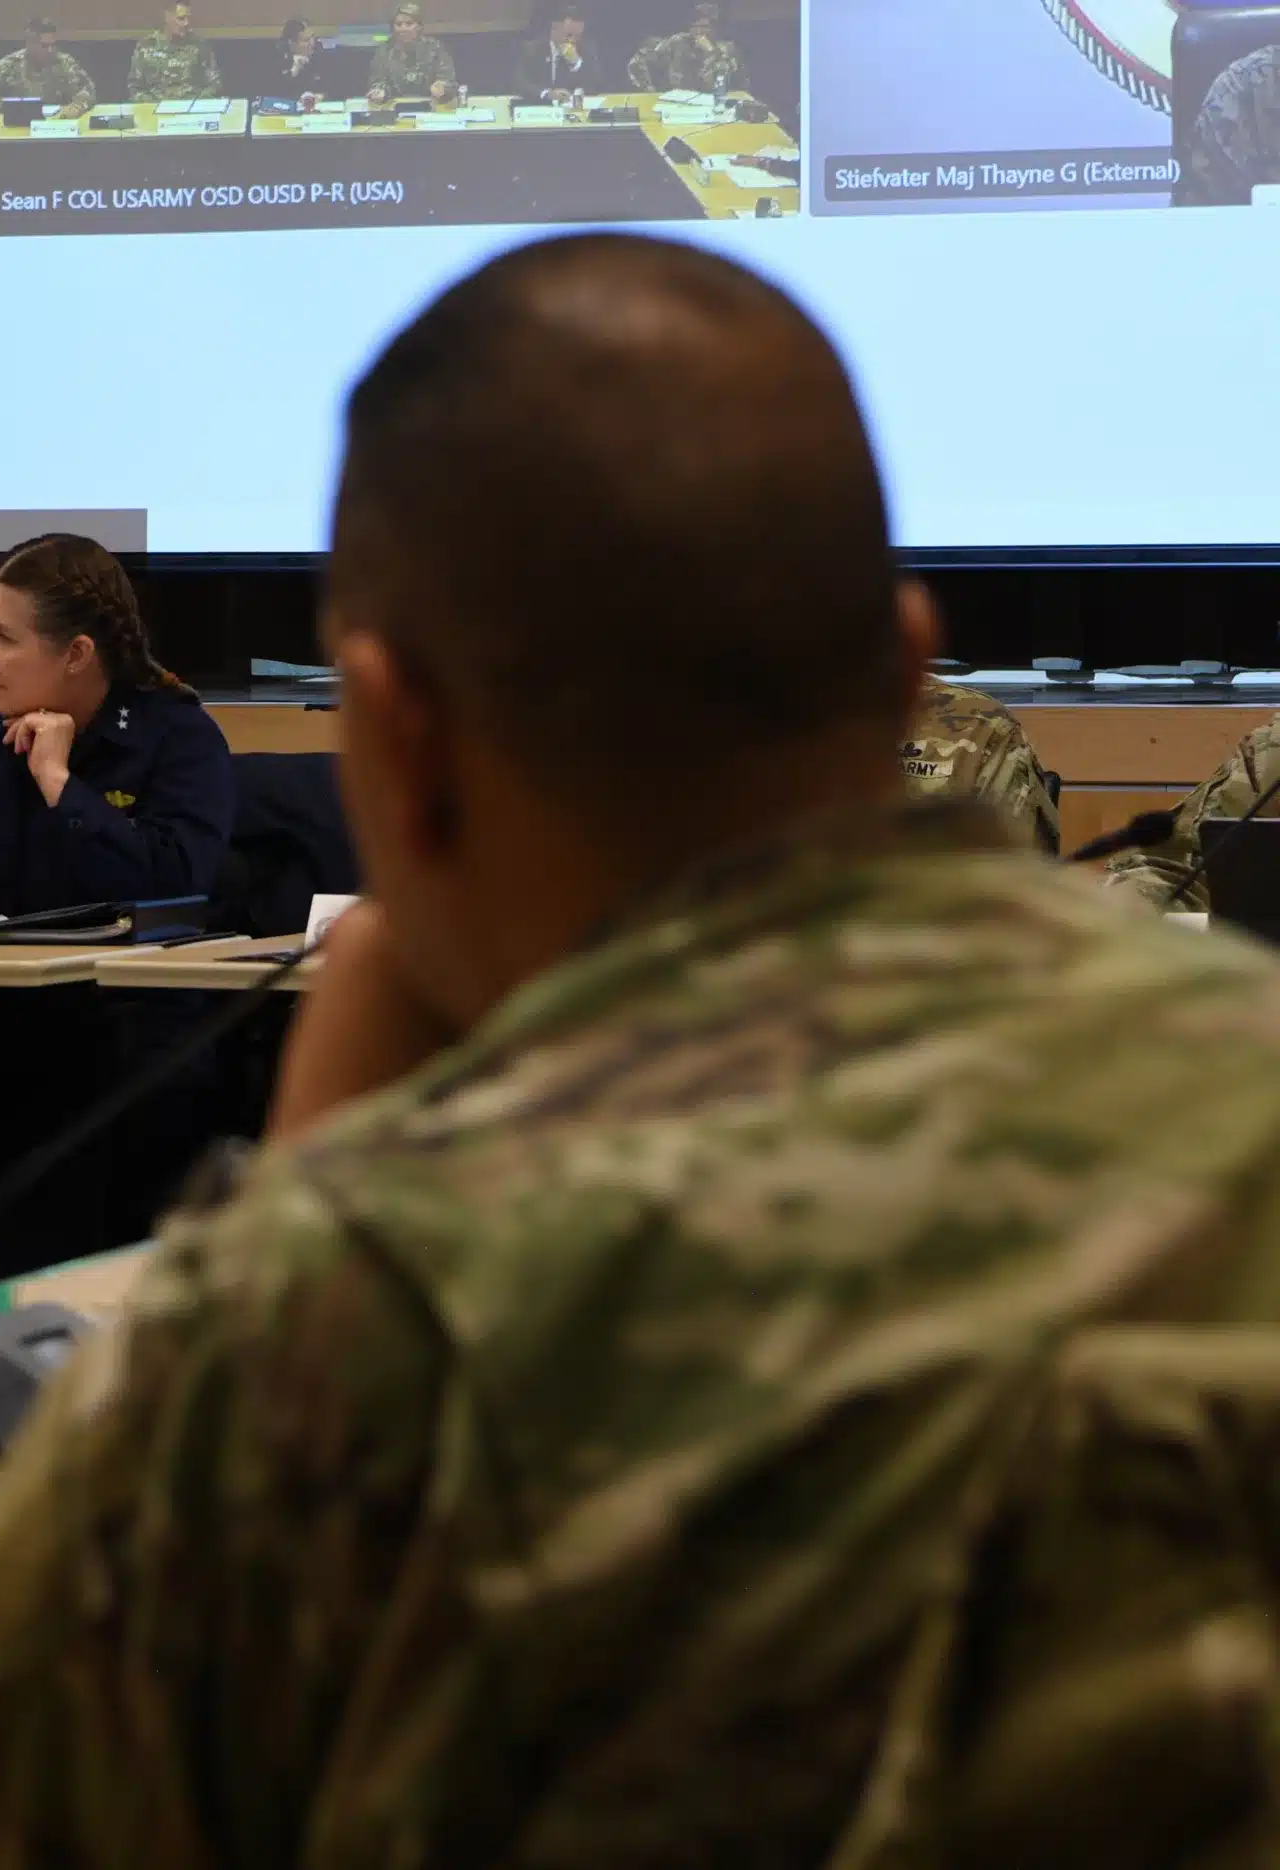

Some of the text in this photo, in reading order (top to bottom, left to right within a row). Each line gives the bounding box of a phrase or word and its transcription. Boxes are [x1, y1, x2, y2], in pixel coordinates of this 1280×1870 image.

[835, 159, 1181, 191] Stiefvater Maj Thayne G (External)
[1, 192, 47, 210] Sean
[52, 191, 63, 209] F
[68, 189, 108, 209] COL
[112, 187, 195, 208] USARMY
[201, 186, 243, 206] OSD
[248, 184, 306, 205] OUSD
[311, 183, 344, 202] P-R
[350, 181, 404, 204] (USA)
